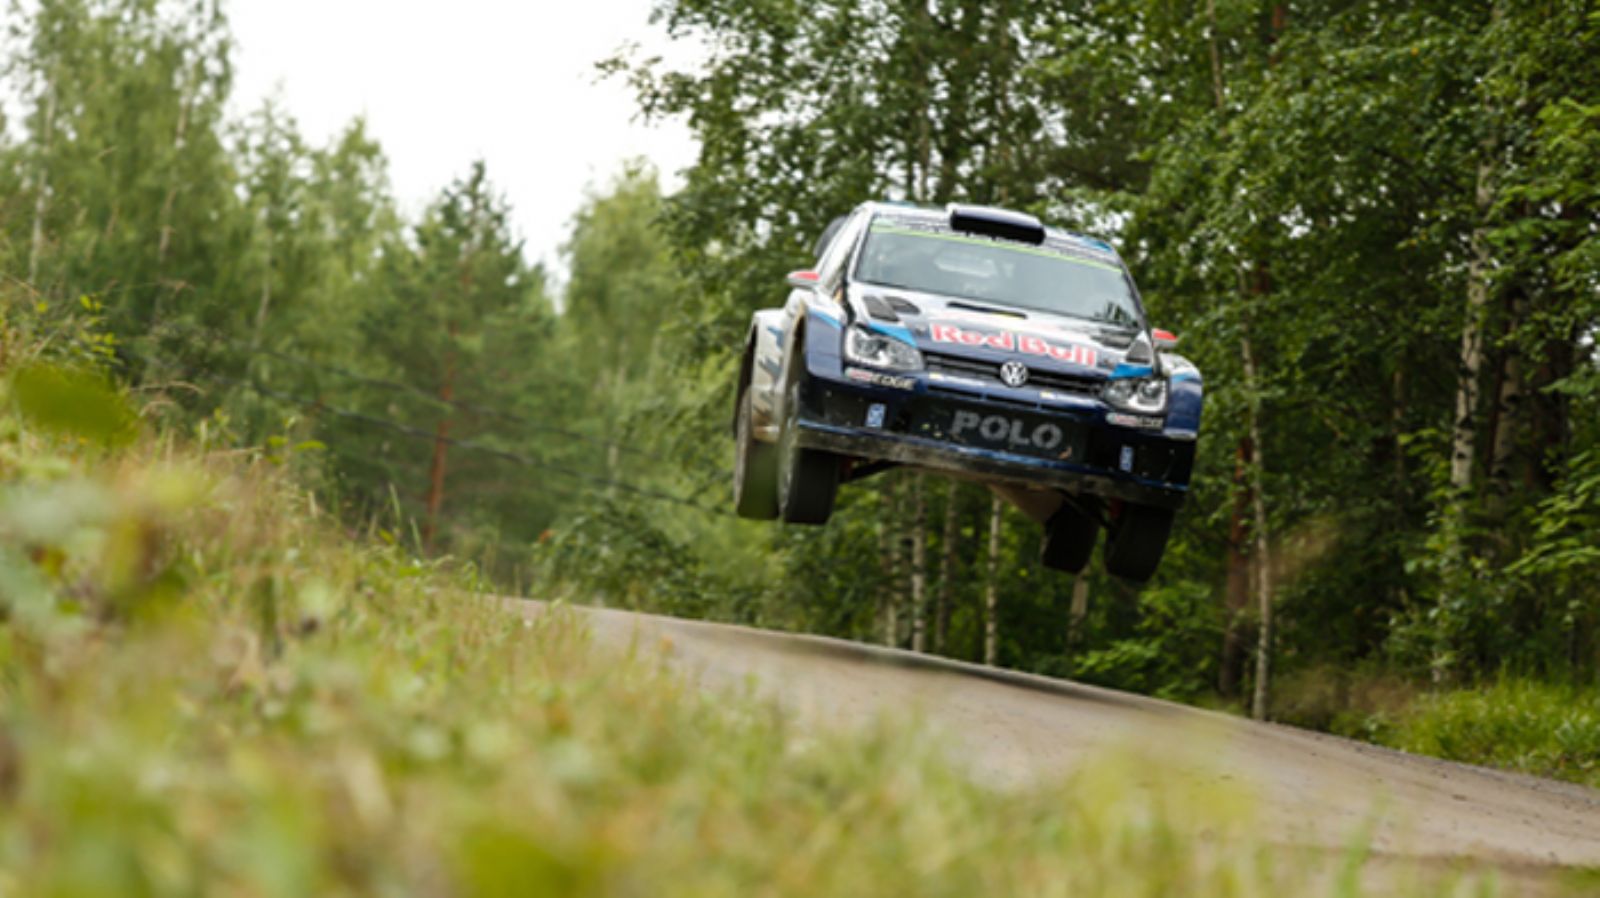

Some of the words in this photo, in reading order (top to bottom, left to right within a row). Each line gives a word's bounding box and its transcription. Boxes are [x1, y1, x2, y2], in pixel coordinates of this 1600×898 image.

[929, 322, 1015, 351] Red
[1018, 333, 1098, 368] Bull
[870, 373, 915, 391] EDGE
[950, 409, 1063, 449] POLO
